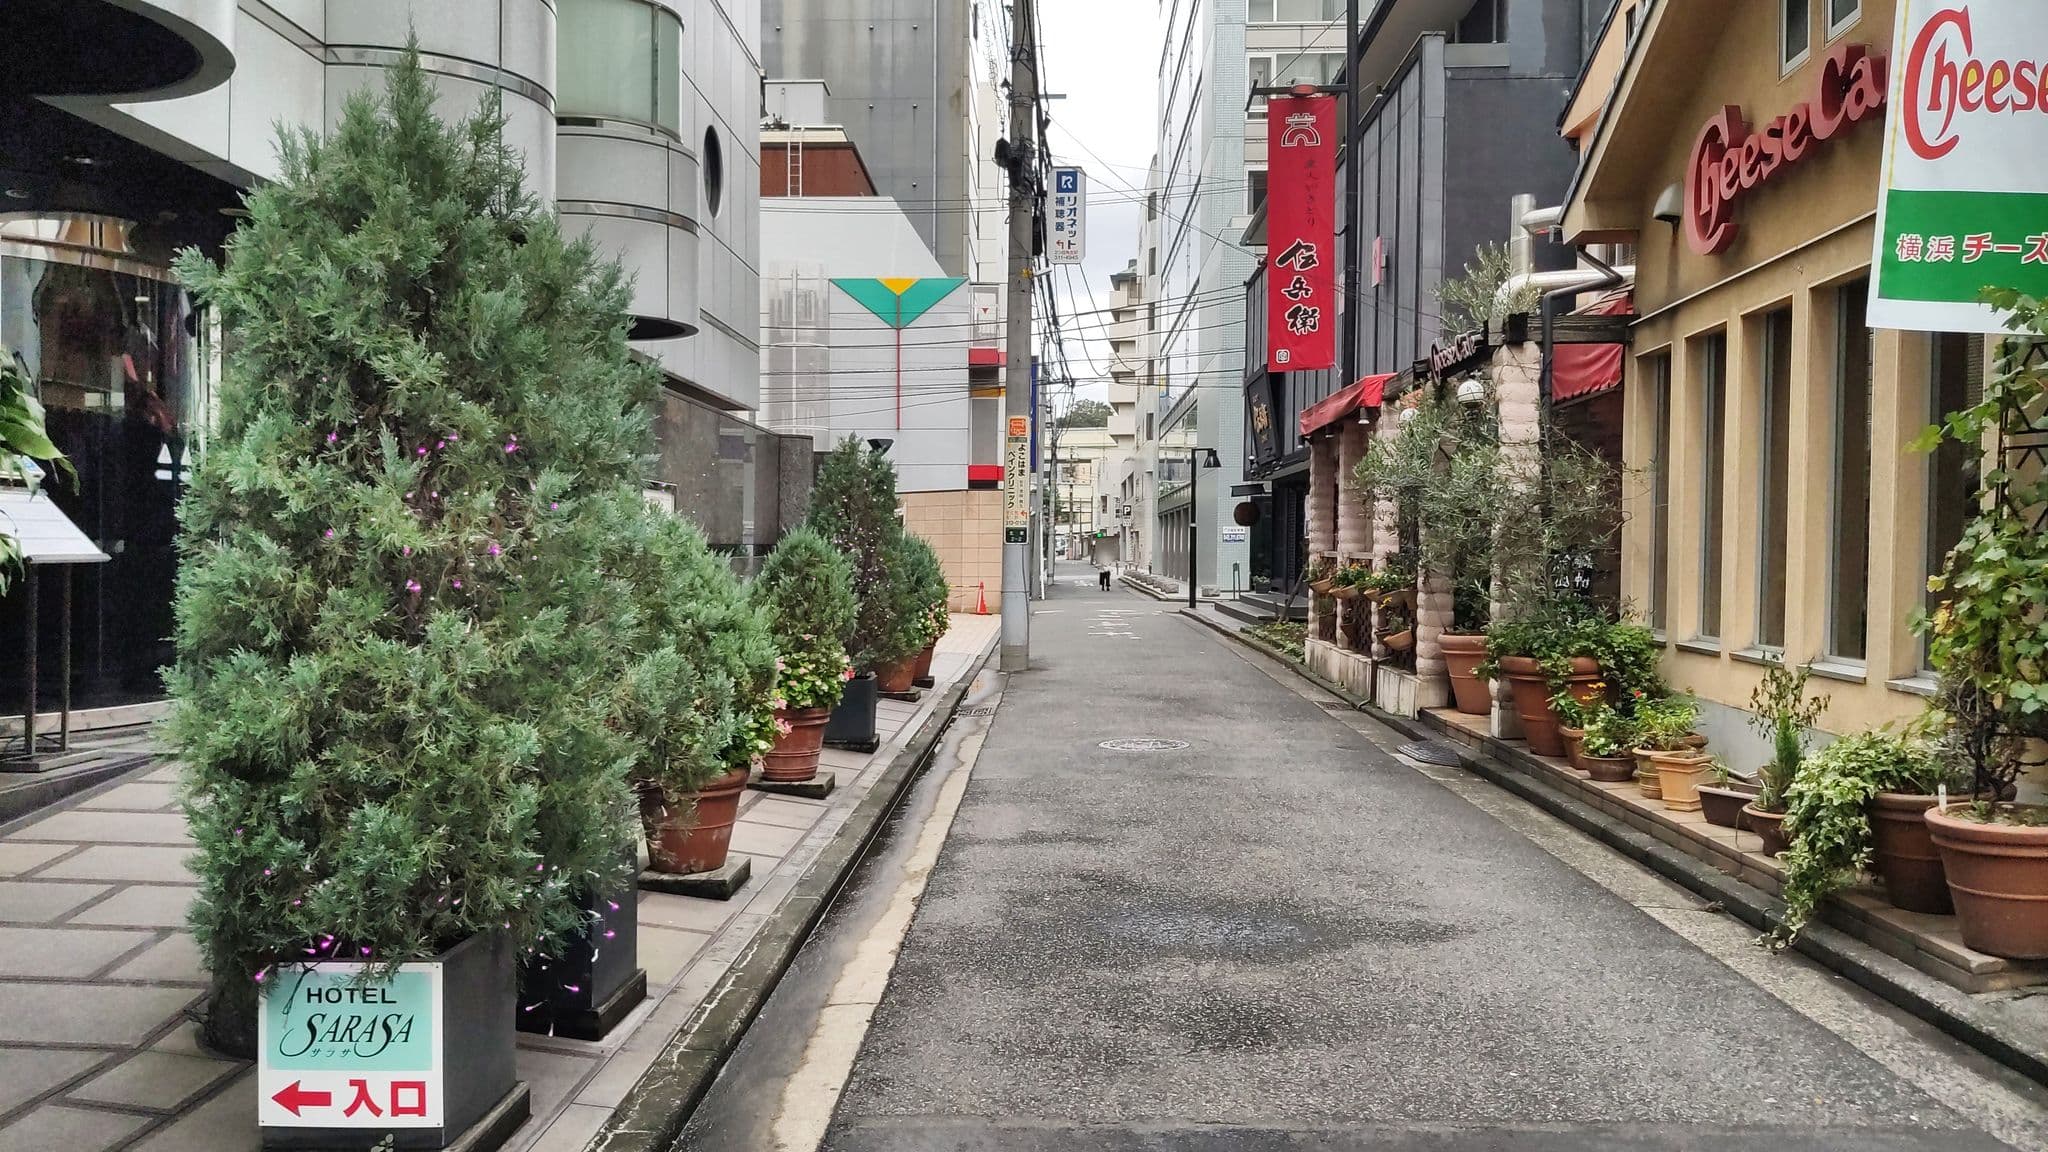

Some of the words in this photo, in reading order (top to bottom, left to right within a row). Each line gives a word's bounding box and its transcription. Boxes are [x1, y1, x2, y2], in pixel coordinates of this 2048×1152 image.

[1683, 44, 1888, 256] CheeseCa
[1055, 196, 1065, 232] 補聴器
[1066, 196, 1077, 250] リオネット
[1276, 238, 1320, 336] 伝兵衛
[1007, 450, 1016, 509] ペインクリニック
[306, 987, 398, 1004] HOTEL
[279, 1013, 415, 1058] SARASA
[343, 1078, 427, 1118] 入口
